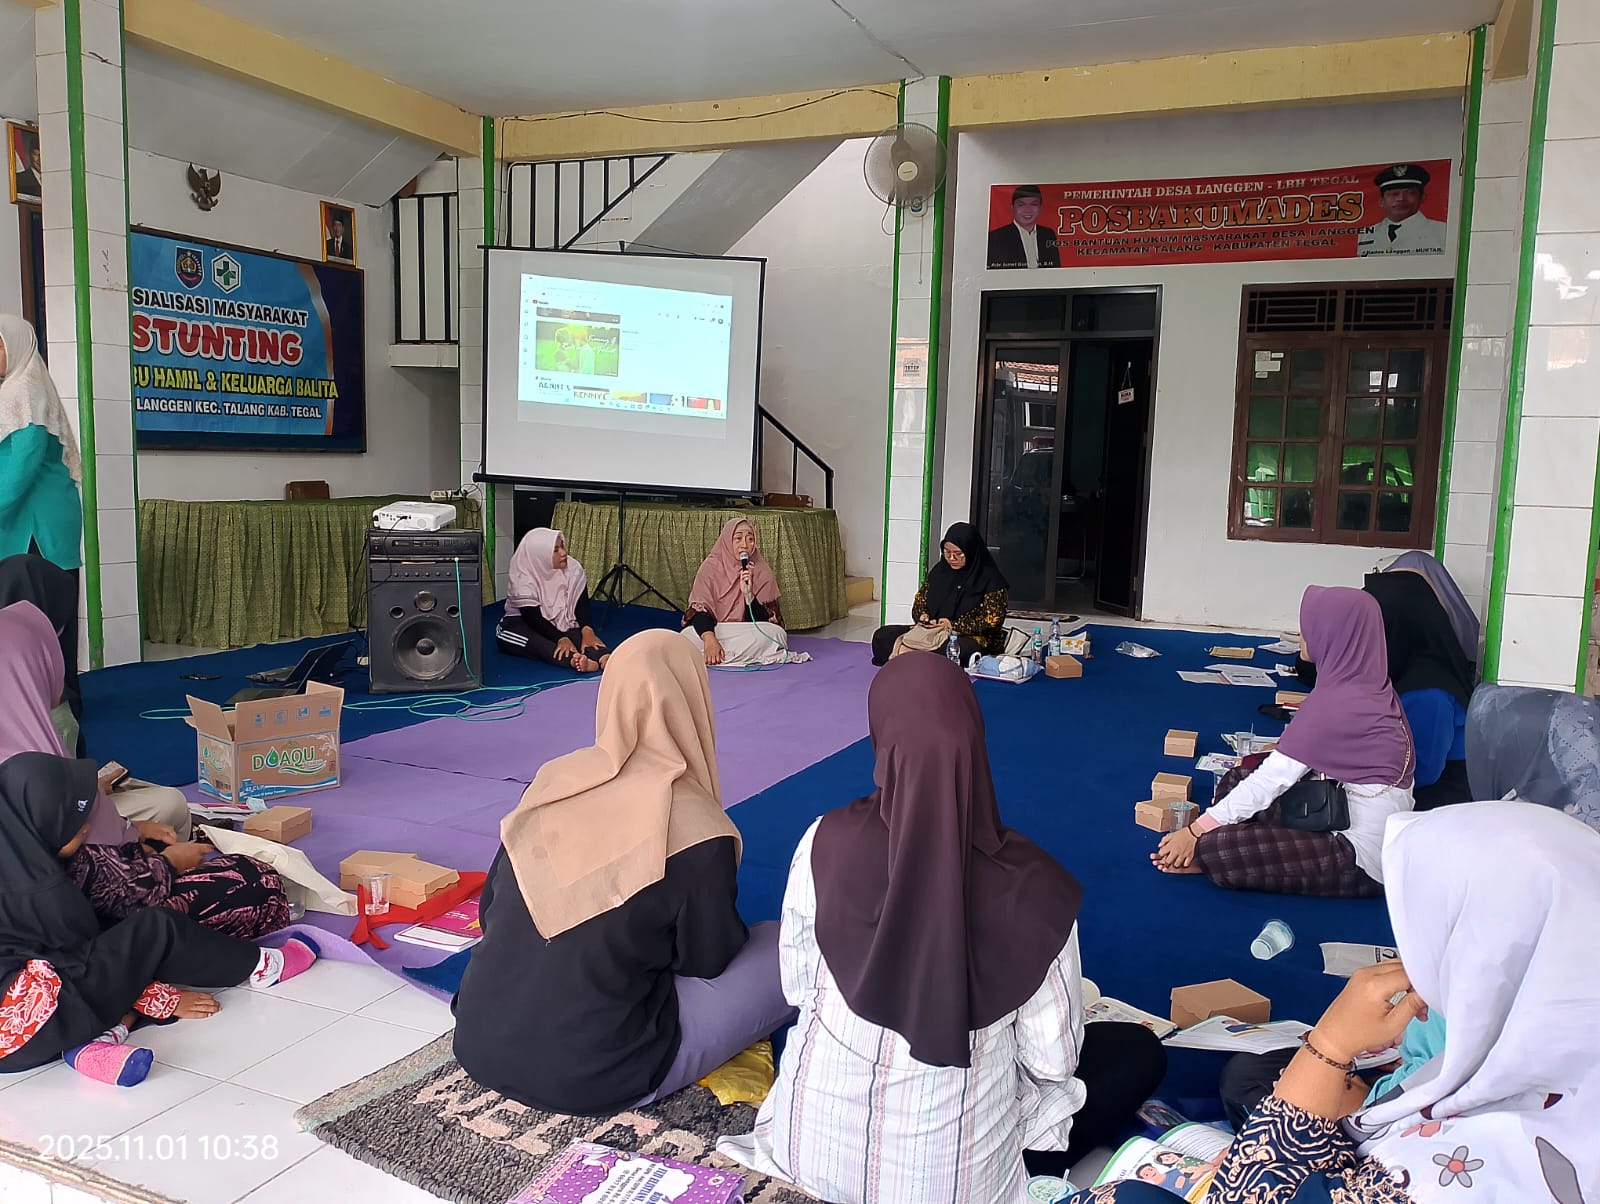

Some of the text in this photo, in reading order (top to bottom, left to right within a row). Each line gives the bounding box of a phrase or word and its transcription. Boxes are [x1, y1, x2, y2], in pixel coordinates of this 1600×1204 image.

[1064, 187, 1152, 200] PEMERINTAH
[1155, 185, 1192, 198] DESA
[1196, 182, 1264, 195] LANGGEN
[1277, 178, 1306, 191] LBH
[1310, 176, 1360, 188] TEGAL
[1058, 192, 1363, 235] POSBAKUMADES
[1046, 226, 1375, 248] POS BANTUAN HUKUM MASYARAKAT DESA LANGGEN
[1077, 238, 1337, 256] KECAMATAN TALANG KABUPATEN TEGAL
[133, 289, 308, 326] SIALISASI MASYARAKAT
[132, 314, 303, 364] STUNTING
[153, 367, 202, 391] HAMIL
[206, 371, 218, 389] &
[221, 372, 293, 396] KELUARGA
[296, 379, 339, 399] BALITA
[136, 398, 322, 418] LANGGEN KEC. TALANG KAB. TEGAL
